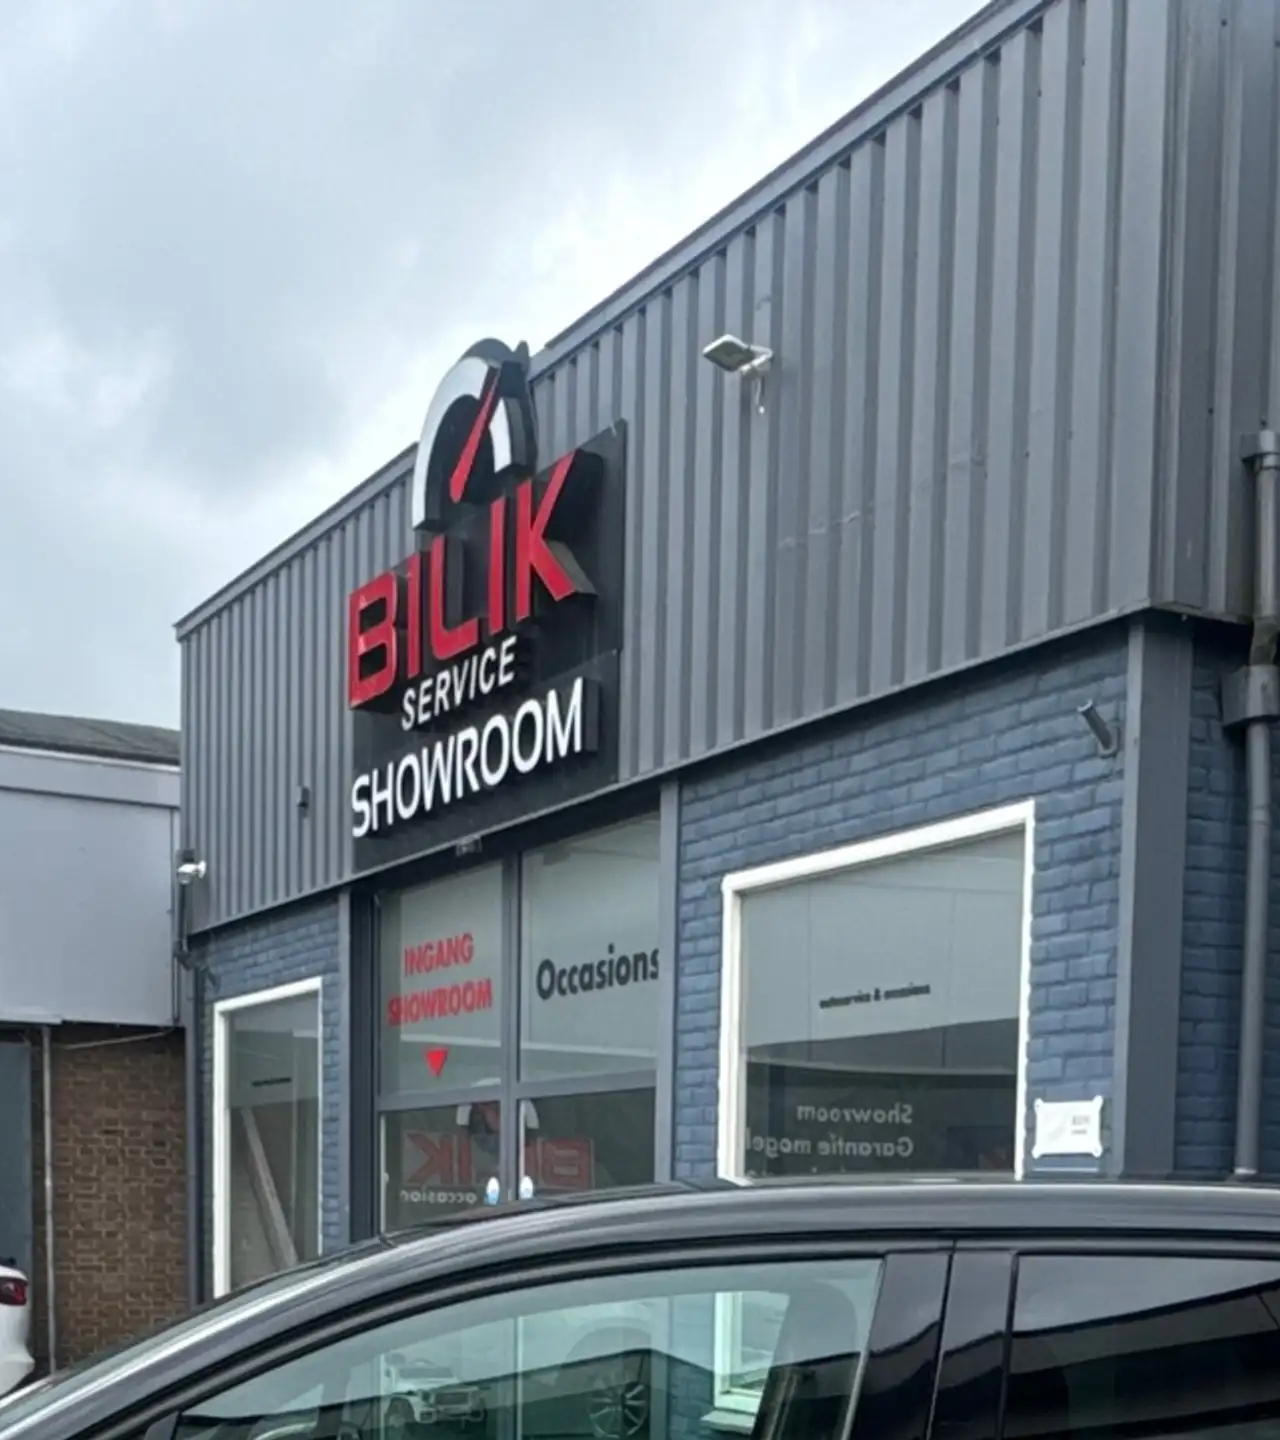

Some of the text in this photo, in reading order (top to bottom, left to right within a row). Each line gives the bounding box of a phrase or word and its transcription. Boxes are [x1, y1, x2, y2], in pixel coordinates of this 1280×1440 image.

[348, 449, 578, 710] BILIK
[401, 635, 517, 731] SERVICE
[352, 677, 584, 838] SHOWROOM
[404, 932, 475, 978] INGANG
[536, 943, 659, 1001] Occasions
[387, 978, 493, 1027] SHOWROOM
